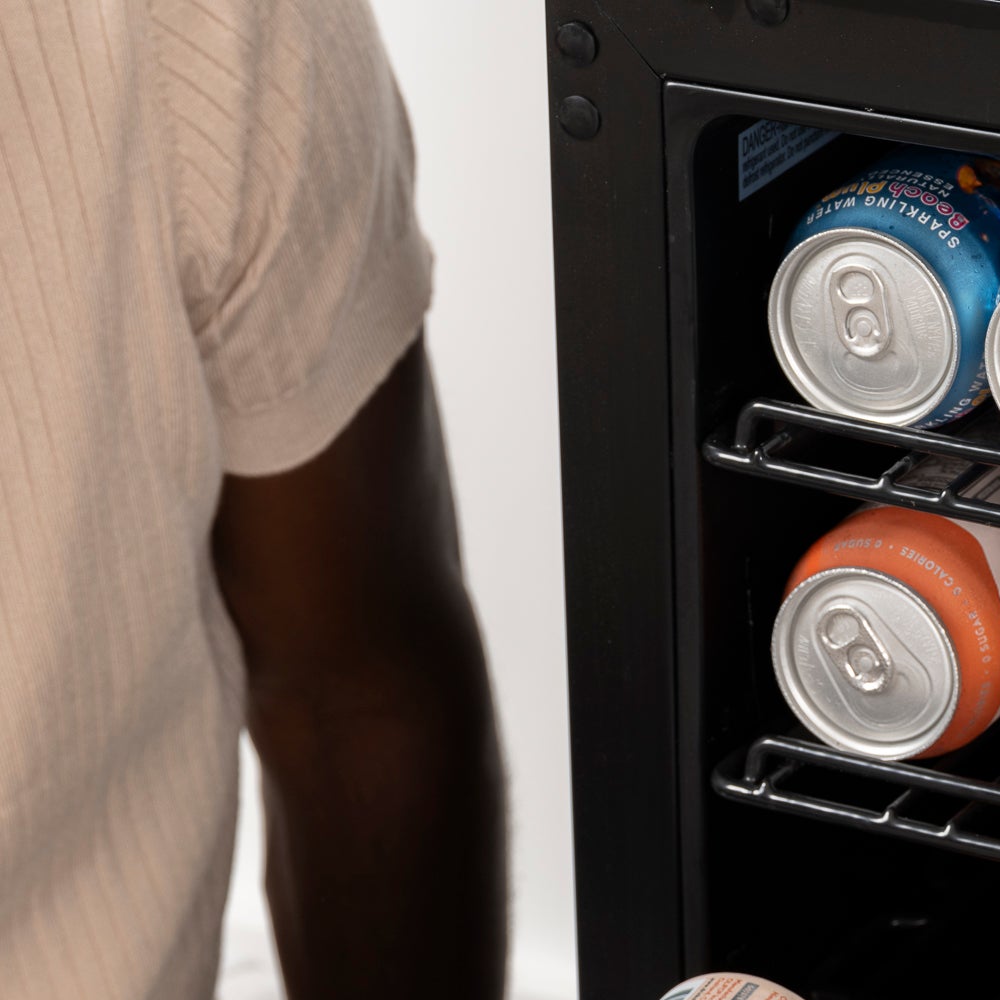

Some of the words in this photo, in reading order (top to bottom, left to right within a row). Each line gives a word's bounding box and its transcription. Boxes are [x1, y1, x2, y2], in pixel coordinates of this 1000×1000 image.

[806, 196, 856, 225] WATER
[864, 195, 960, 249] SPARKLING
[888, 182, 970, 231] Beach
[900, 546, 955, 588] CALORIES
[968, 610, 990, 653] SUGAR
